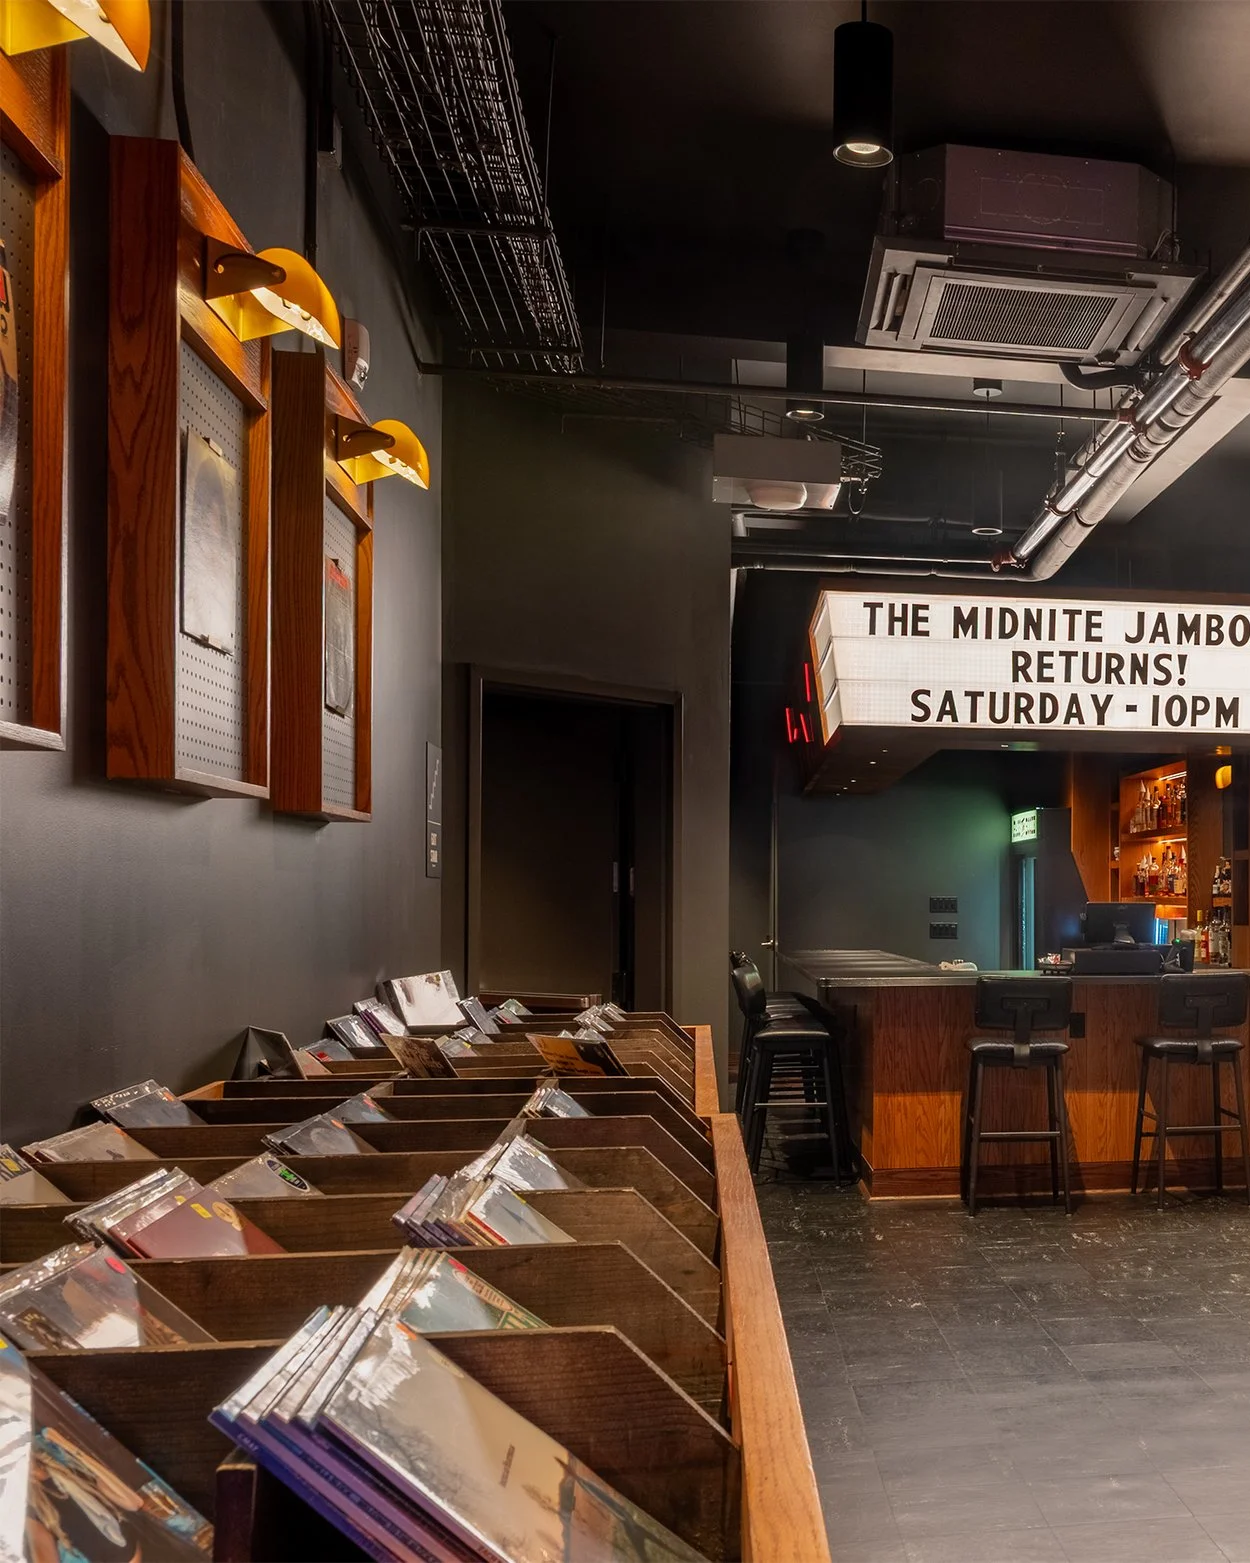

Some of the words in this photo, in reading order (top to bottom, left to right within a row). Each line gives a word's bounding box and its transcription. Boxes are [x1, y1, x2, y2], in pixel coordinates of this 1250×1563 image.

[863, 602, 931, 638] THE
[952, 605, 1103, 643] MIDNITE
[1012, 650, 1189, 687] RETURNS!
[911, 689, 1114, 726] SATURDAY
